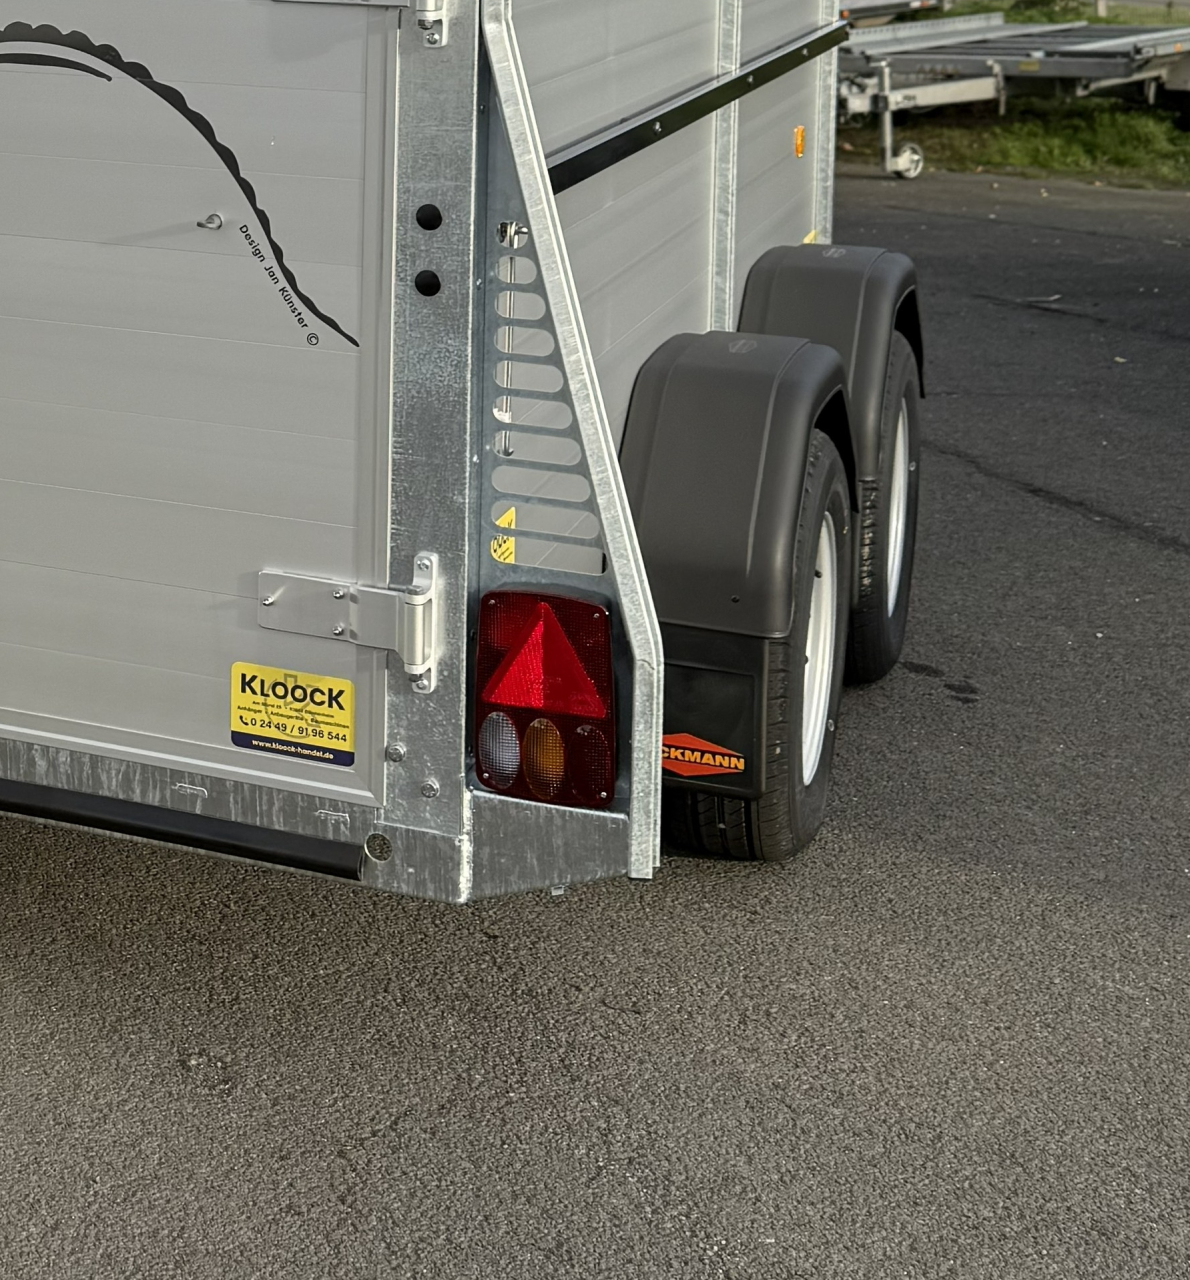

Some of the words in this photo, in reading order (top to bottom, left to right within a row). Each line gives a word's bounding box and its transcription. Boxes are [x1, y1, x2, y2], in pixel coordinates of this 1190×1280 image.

[238, 224, 266, 263] Design
[264, 265, 280, 285] Jan
[278, 286, 309, 328] Künster
[240, 673, 346, 711] KLOOCK
[250, 717, 257, 726] 0
[327, 731, 347, 743] 544
[251, 739, 334, 759] www.kloock-handel.de
[662, 745, 745, 770] CKMANN
